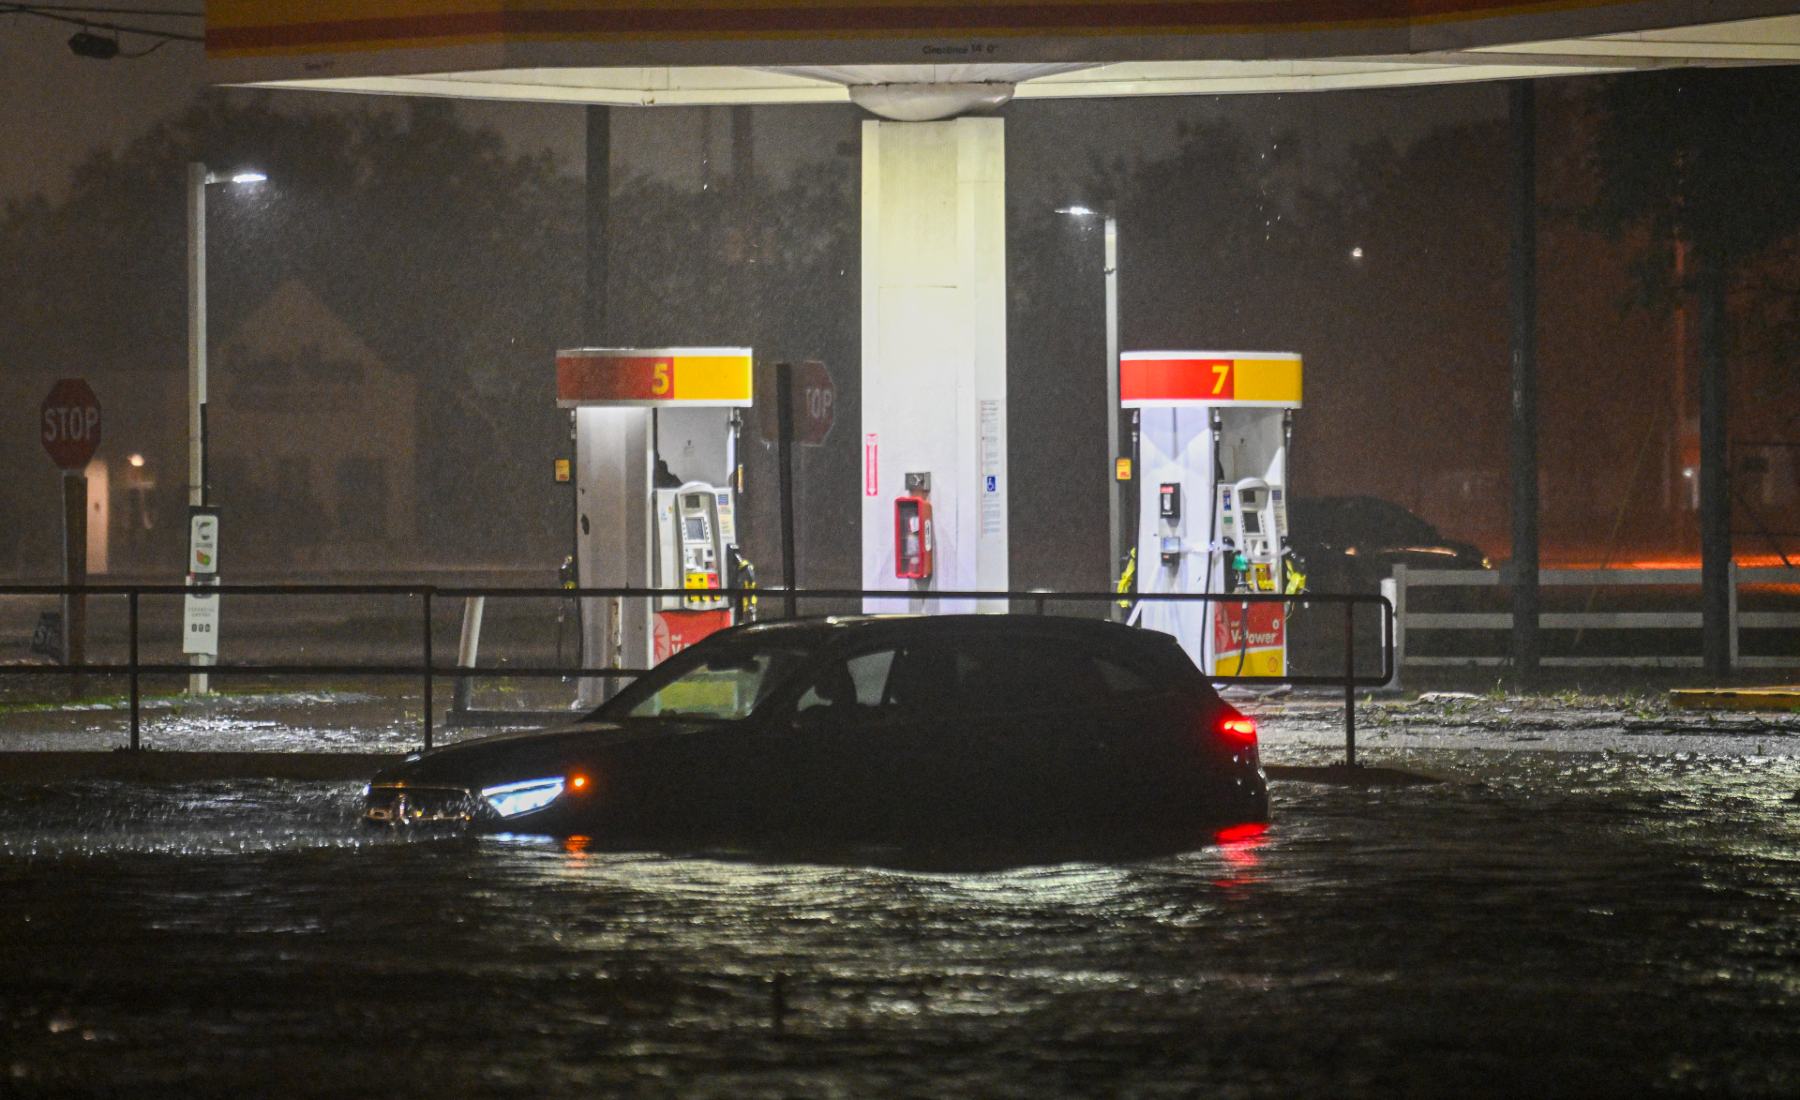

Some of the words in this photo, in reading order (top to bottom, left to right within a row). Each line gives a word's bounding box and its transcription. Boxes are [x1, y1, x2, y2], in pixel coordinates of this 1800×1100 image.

[651, 363, 670, 395] 5
[1211, 365, 1230, 395] 7
[804, 388, 832, 418] TOP
[43, 406, 98, 442] STOP
